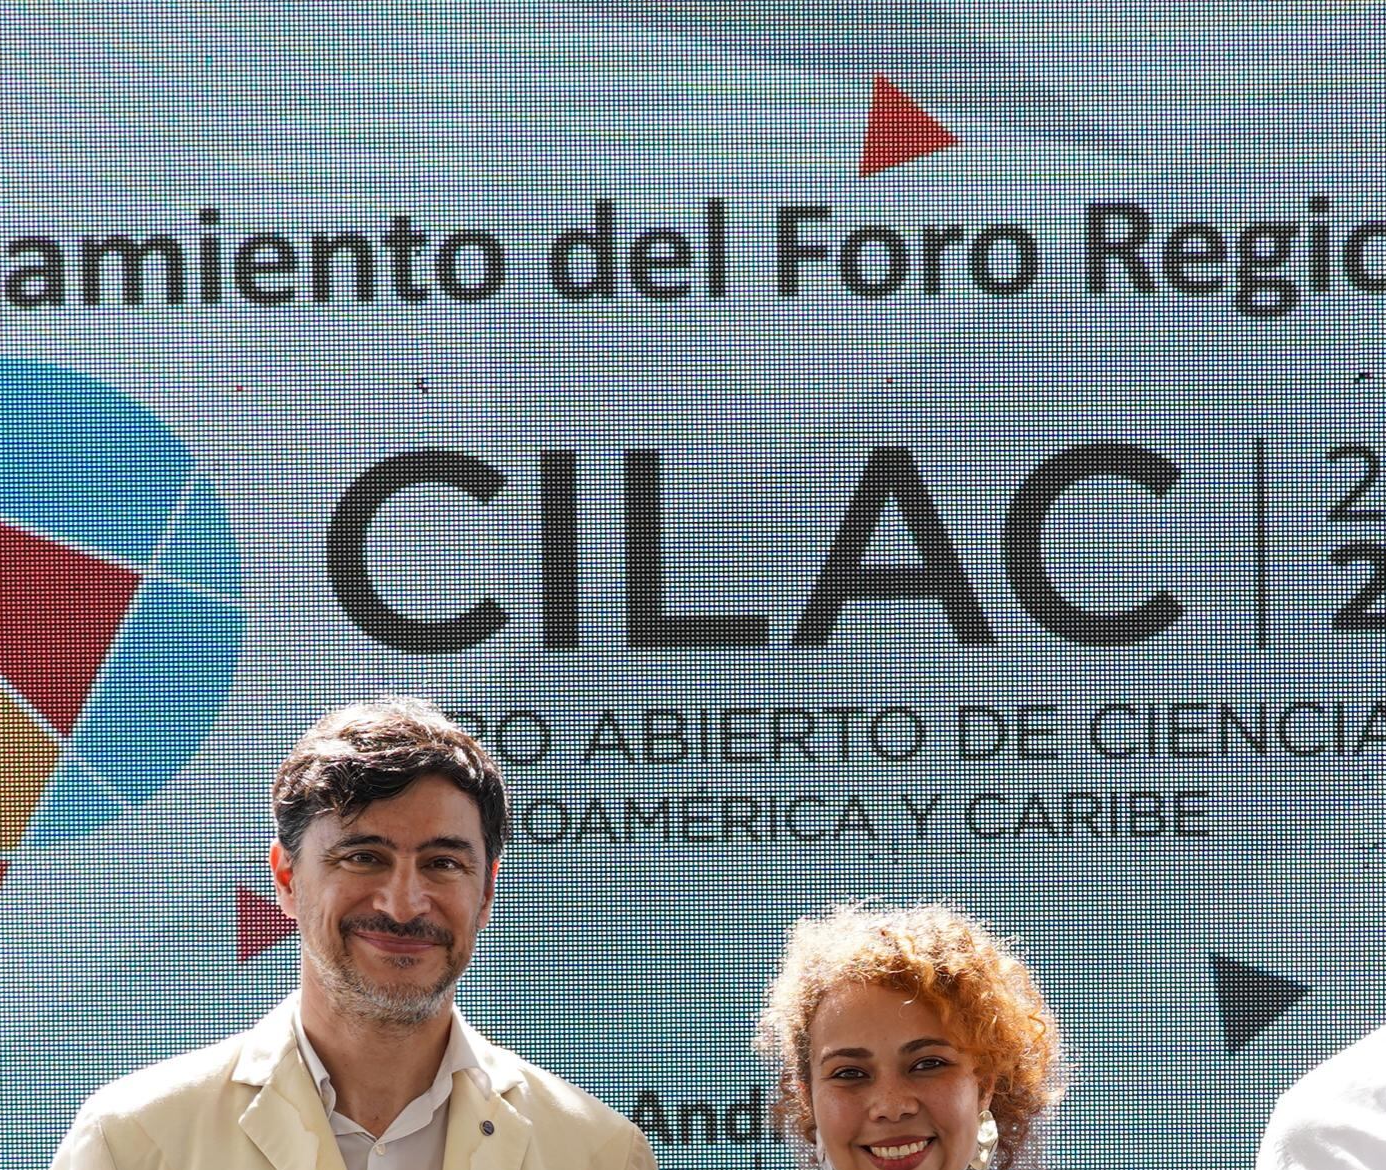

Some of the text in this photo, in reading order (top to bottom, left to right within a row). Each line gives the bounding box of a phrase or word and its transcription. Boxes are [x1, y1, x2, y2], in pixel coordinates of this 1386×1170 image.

[550, 200, 726, 302] del
[777, 205, 1039, 299] Foro
[326, 441, 1185, 655] CILAC
[581, 704, 927, 766] ABIERTO
[958, 703, 1059, 762] DE
[507, 785, 1209, 847] OAMÉRICA Y CARIBE
